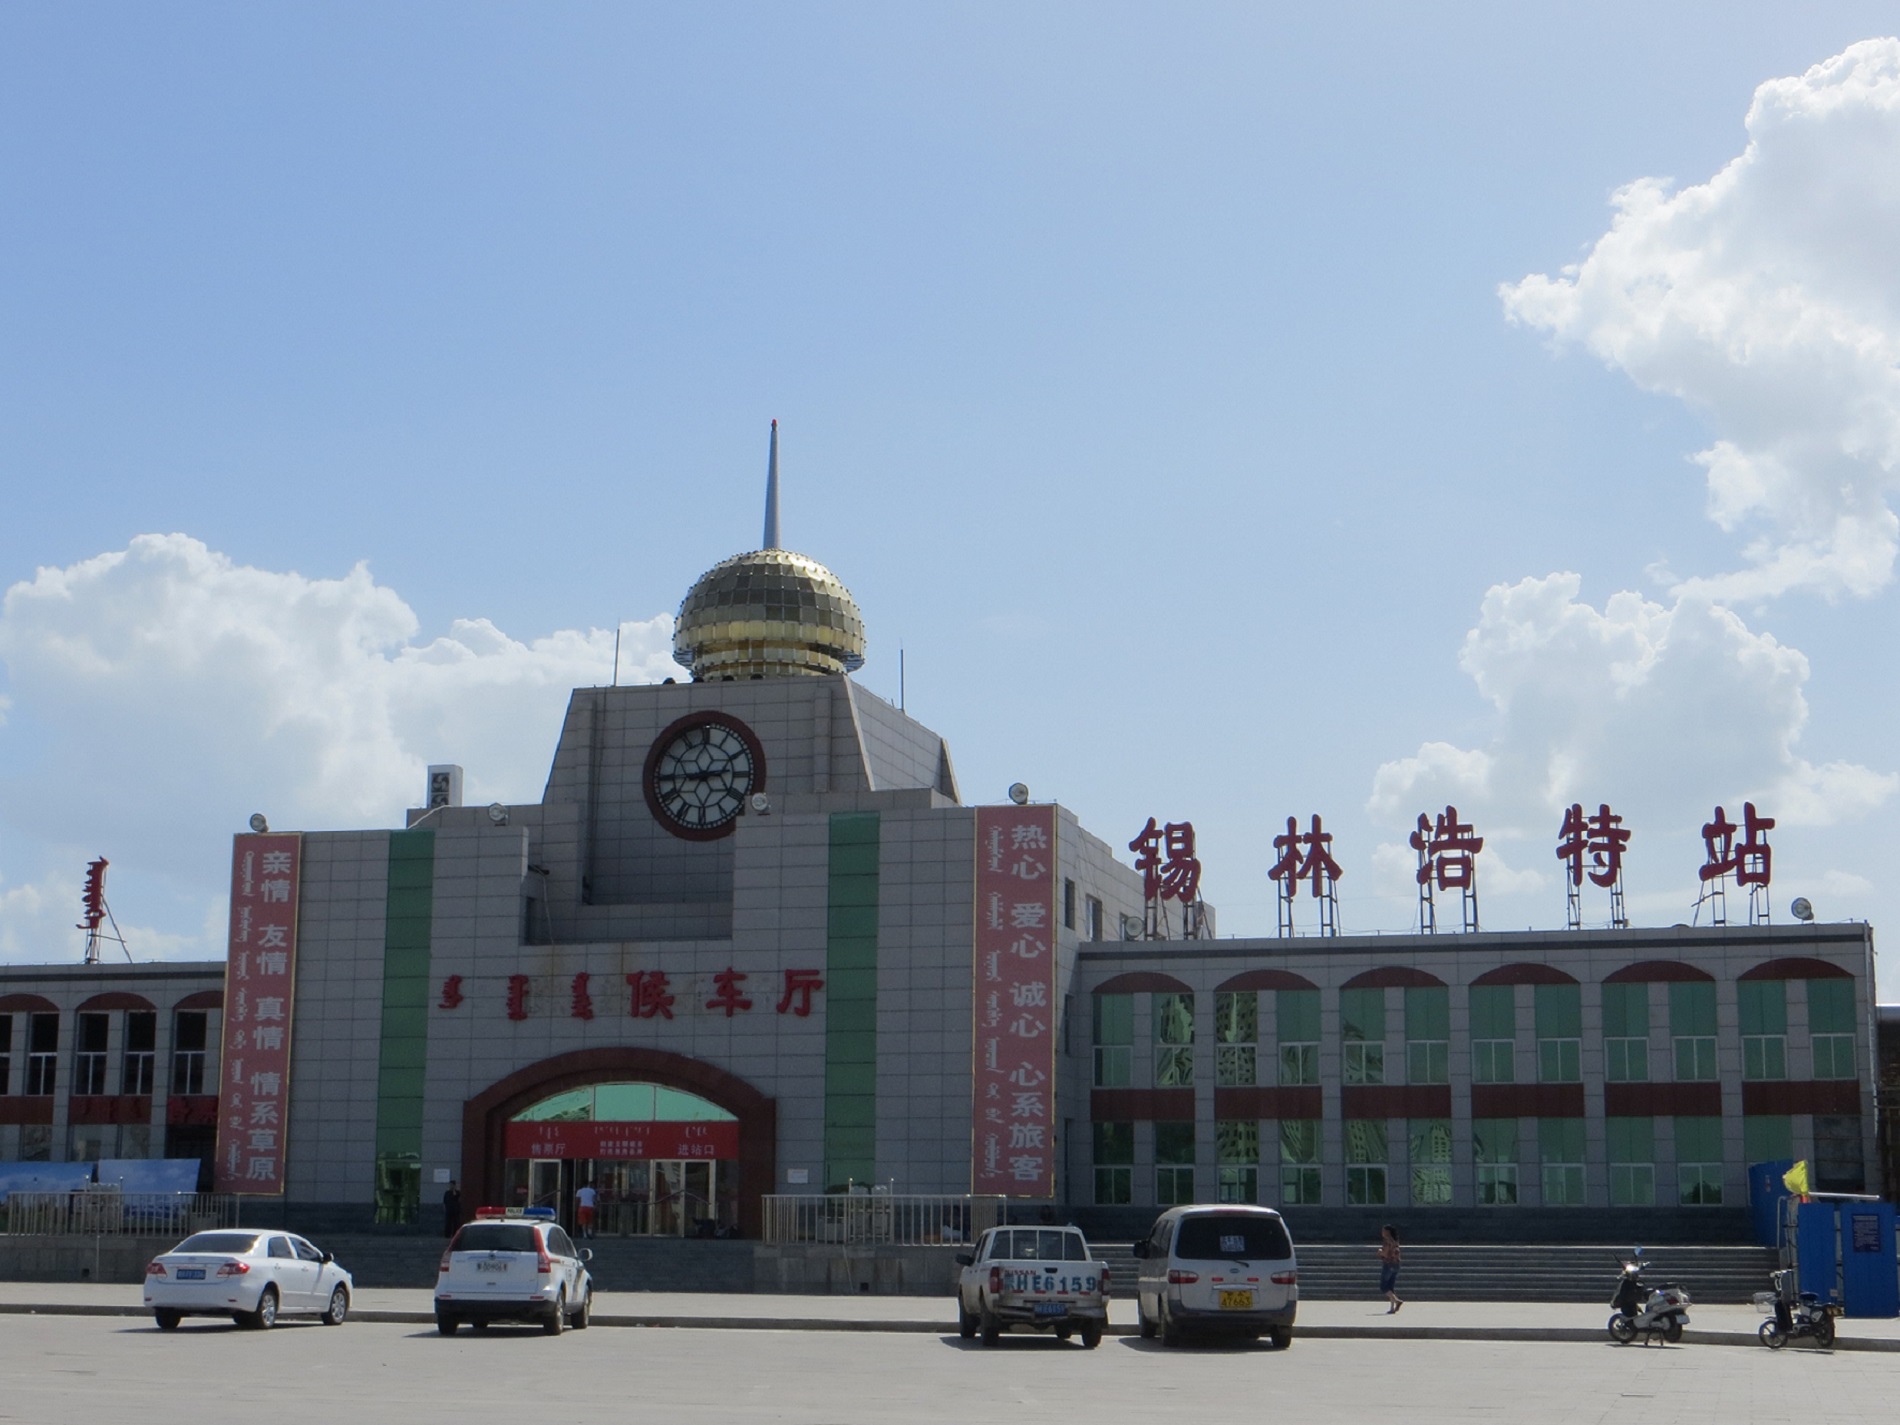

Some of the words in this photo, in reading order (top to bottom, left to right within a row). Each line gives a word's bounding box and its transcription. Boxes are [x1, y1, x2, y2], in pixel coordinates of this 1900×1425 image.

[261, 851, 291, 903] 亲情
[1012, 825, 1047, 880] 热心
[1129, 802, 1775, 902] 锡林浩特站
[257, 924, 288, 975] 友情
[1010, 903, 1046, 959] 爱心
[627, 967, 825, 1019] 候车厅
[1009, 981, 1046, 1038] 诚心
[253, 997, 284, 1050] 真情
[247, 1072, 281, 1180] 情系草原
[1008, 1061, 1046, 1181] 心系旅客
[677, 1143, 715, 1156] 进站口
[1004, 1268, 1037, 1276] NISSAN
